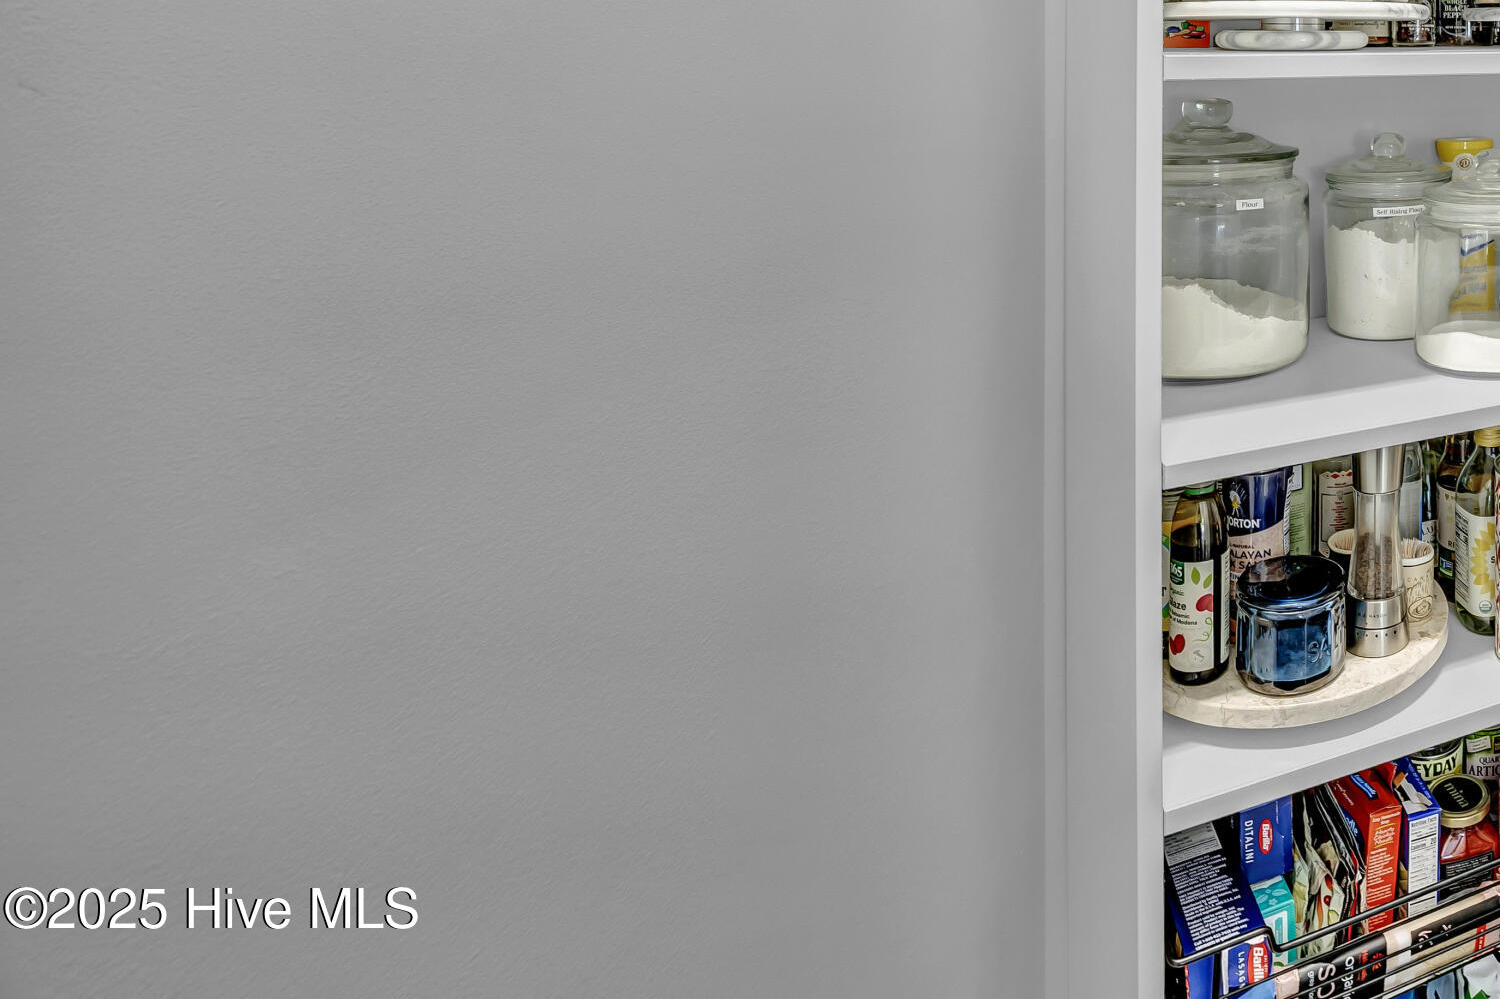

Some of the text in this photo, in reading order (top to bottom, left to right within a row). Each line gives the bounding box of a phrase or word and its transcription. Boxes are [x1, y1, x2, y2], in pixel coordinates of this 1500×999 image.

[1443, 782, 1470, 809] mina
[1244, 819, 1254, 864] DITALINI
[1262, 823, 1271, 851] Barilla
